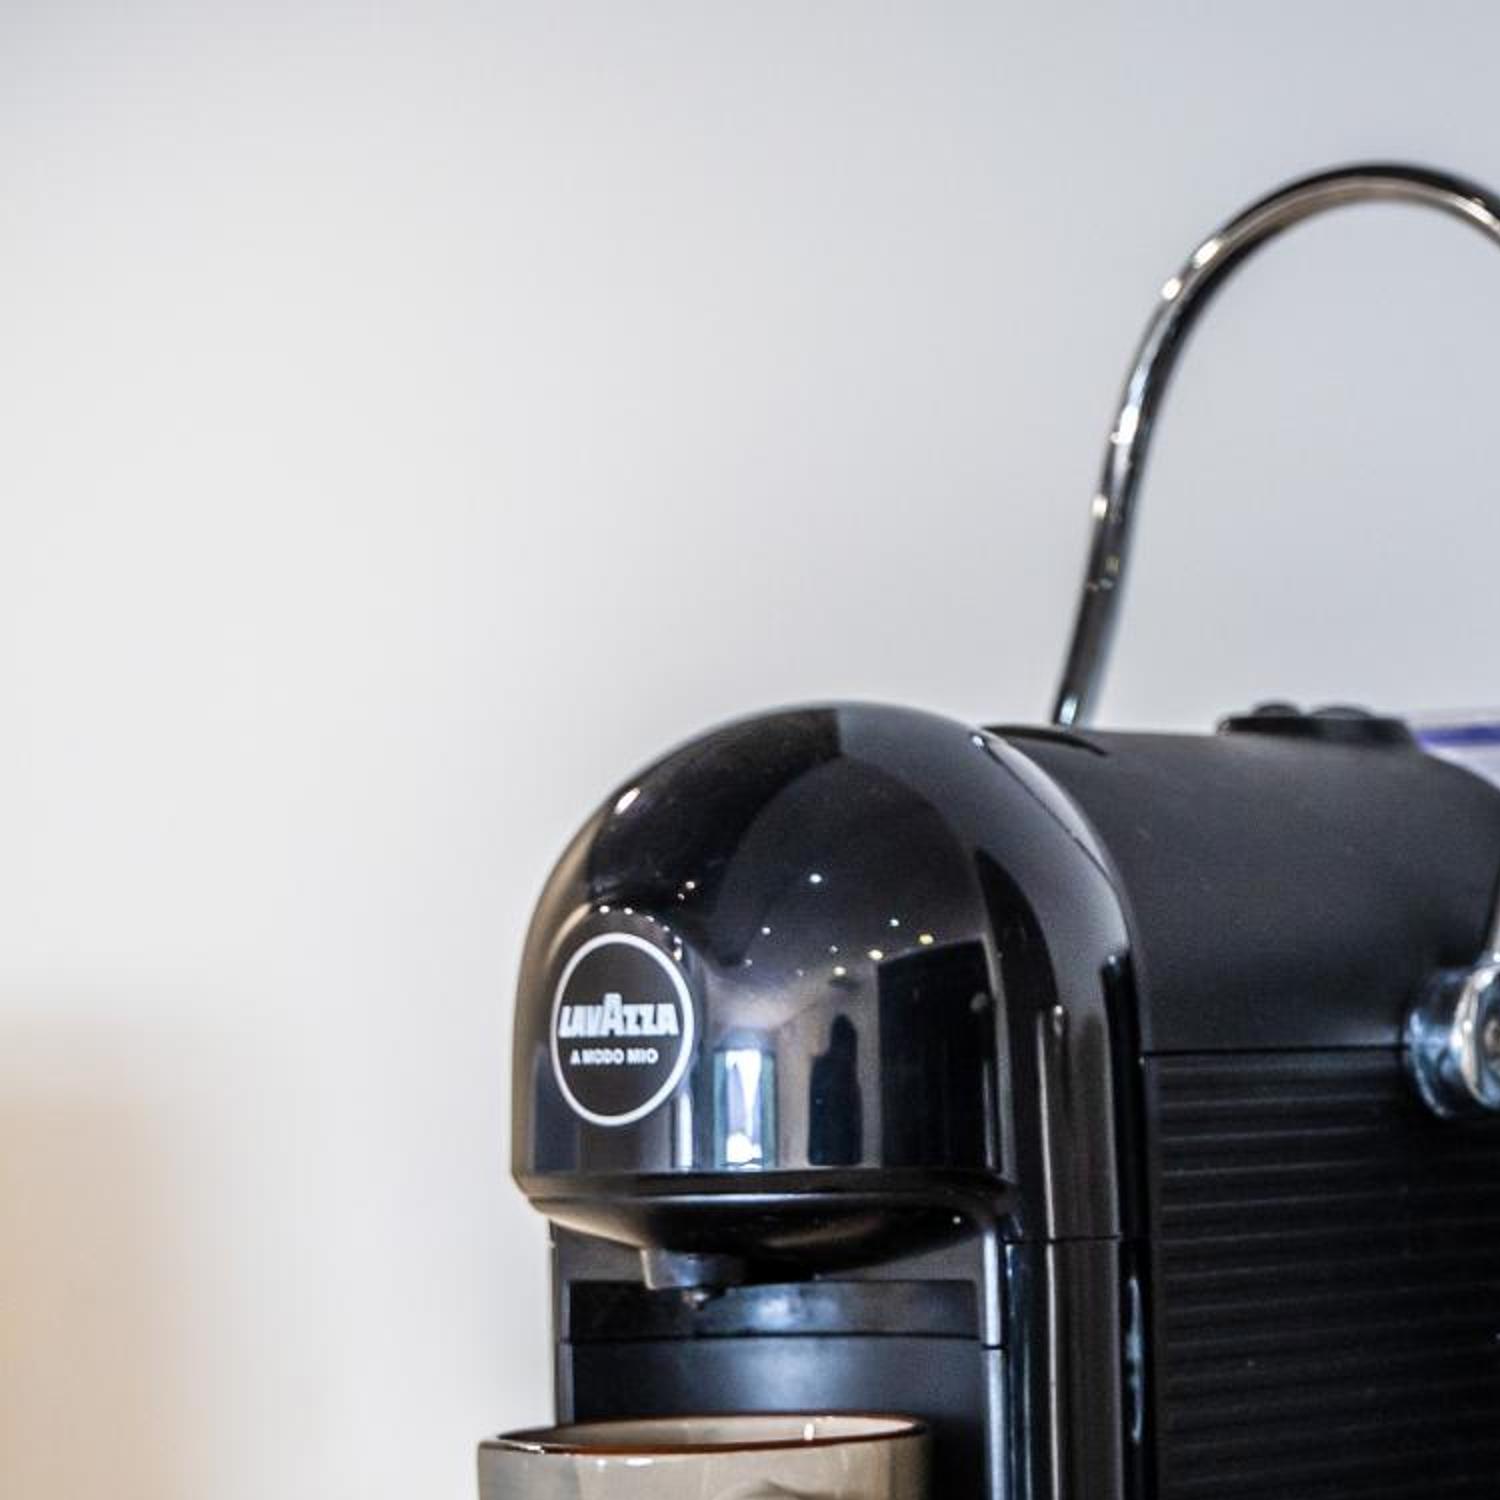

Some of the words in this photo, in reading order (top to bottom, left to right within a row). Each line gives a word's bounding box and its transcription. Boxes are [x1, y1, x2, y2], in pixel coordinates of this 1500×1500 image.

[559, 993, 679, 1038] LAVAZZA
[570, 1049, 581, 1064] A
[582, 1048, 625, 1065] MODO
[627, 1048, 659, 1064] MIO
